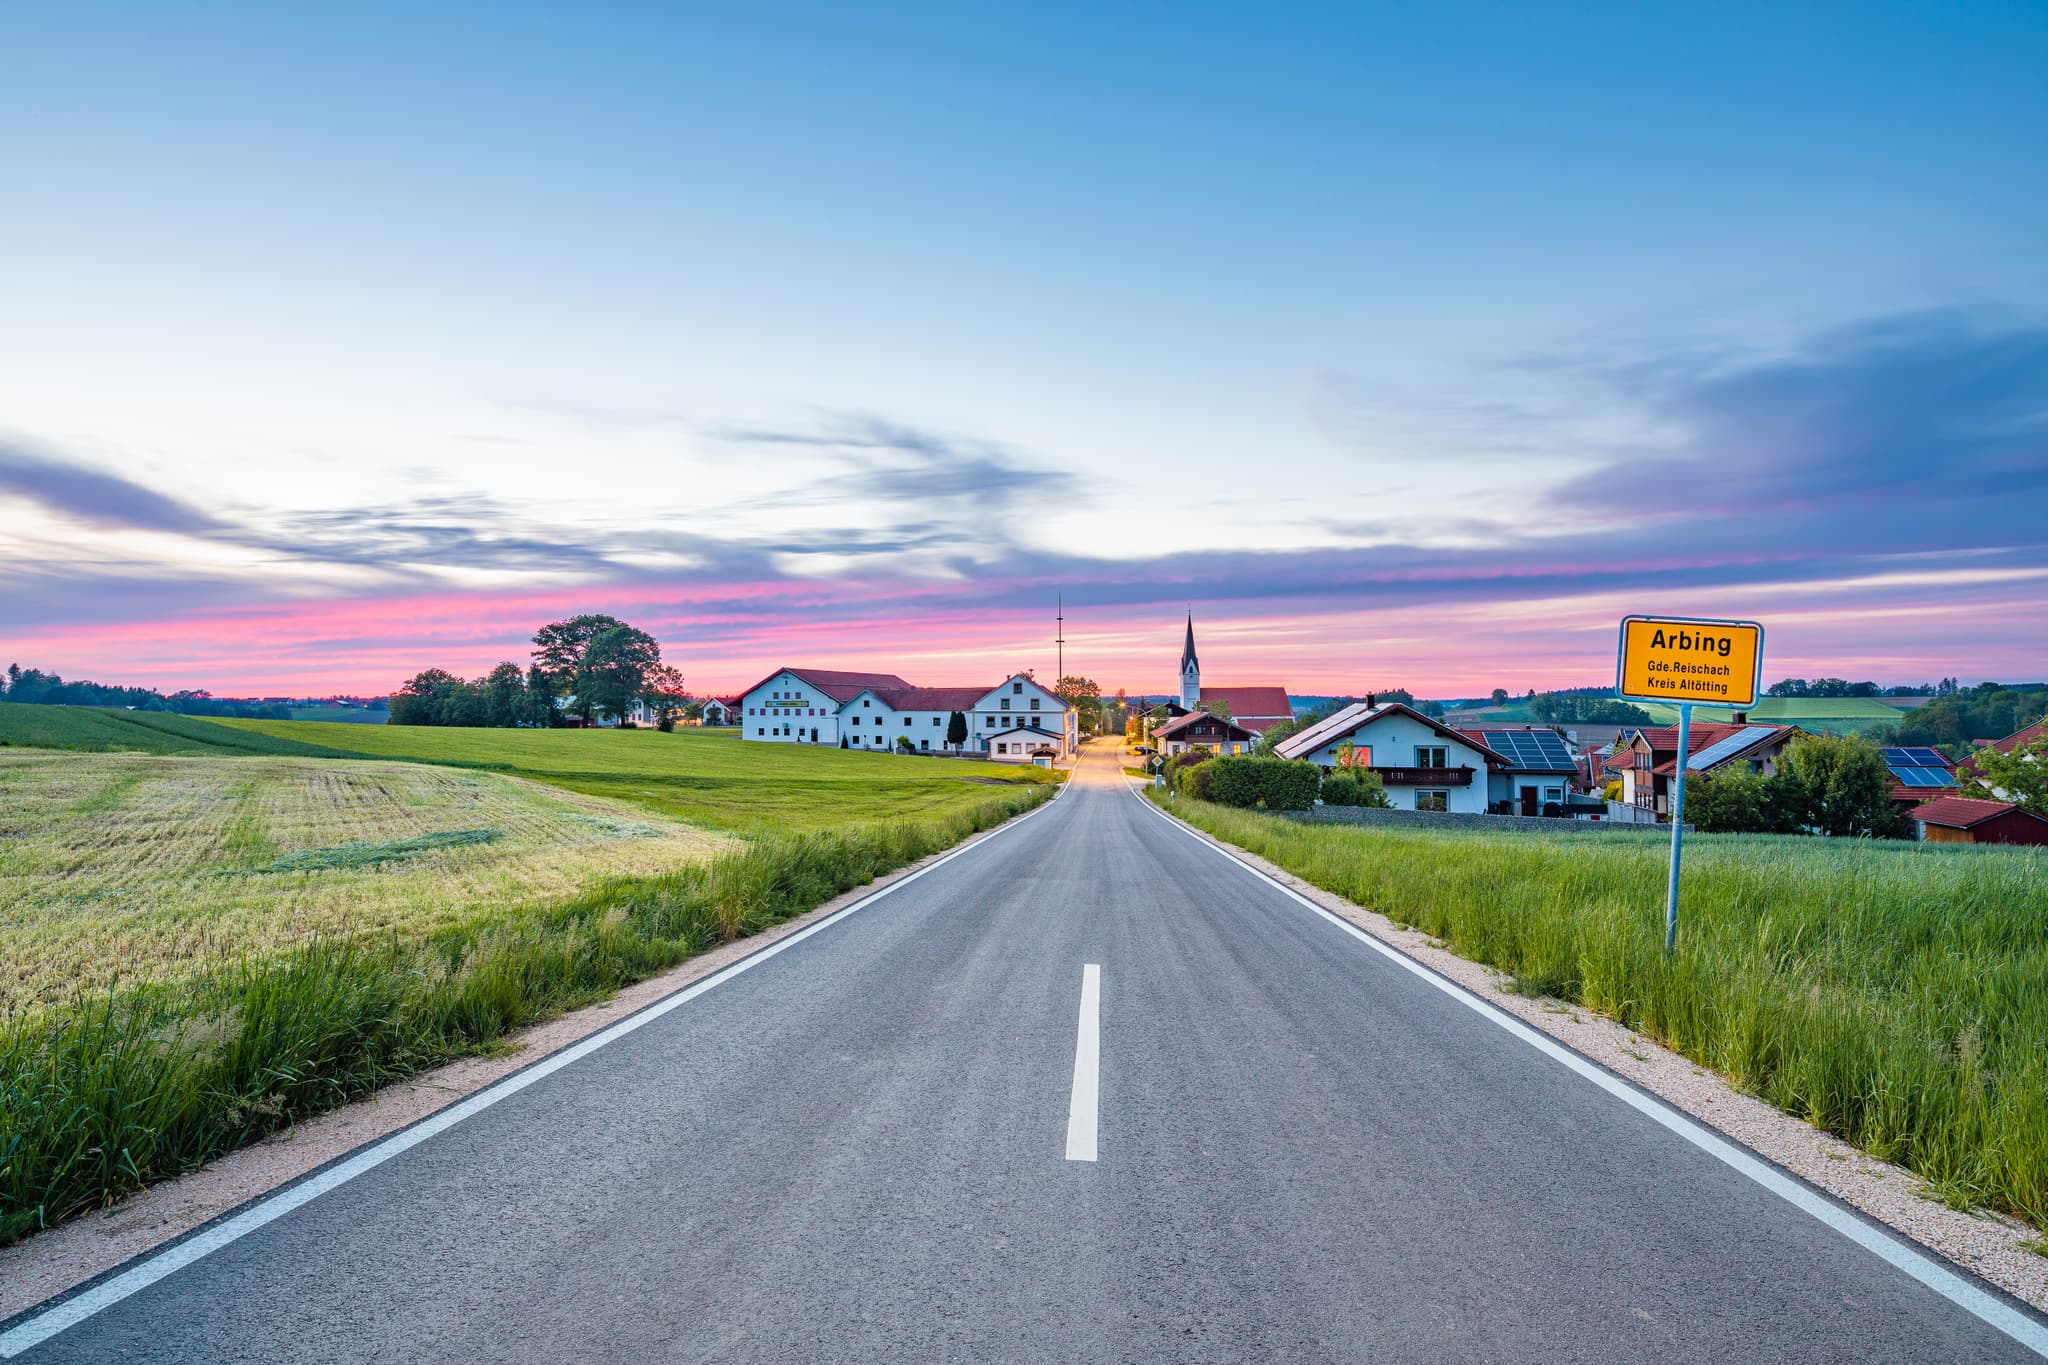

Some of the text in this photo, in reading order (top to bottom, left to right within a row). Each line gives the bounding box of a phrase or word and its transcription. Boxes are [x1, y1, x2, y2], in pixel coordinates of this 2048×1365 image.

[1651, 629, 1732, 656] Arbing
[1647, 676, 1728, 695] Kreis Altötting
